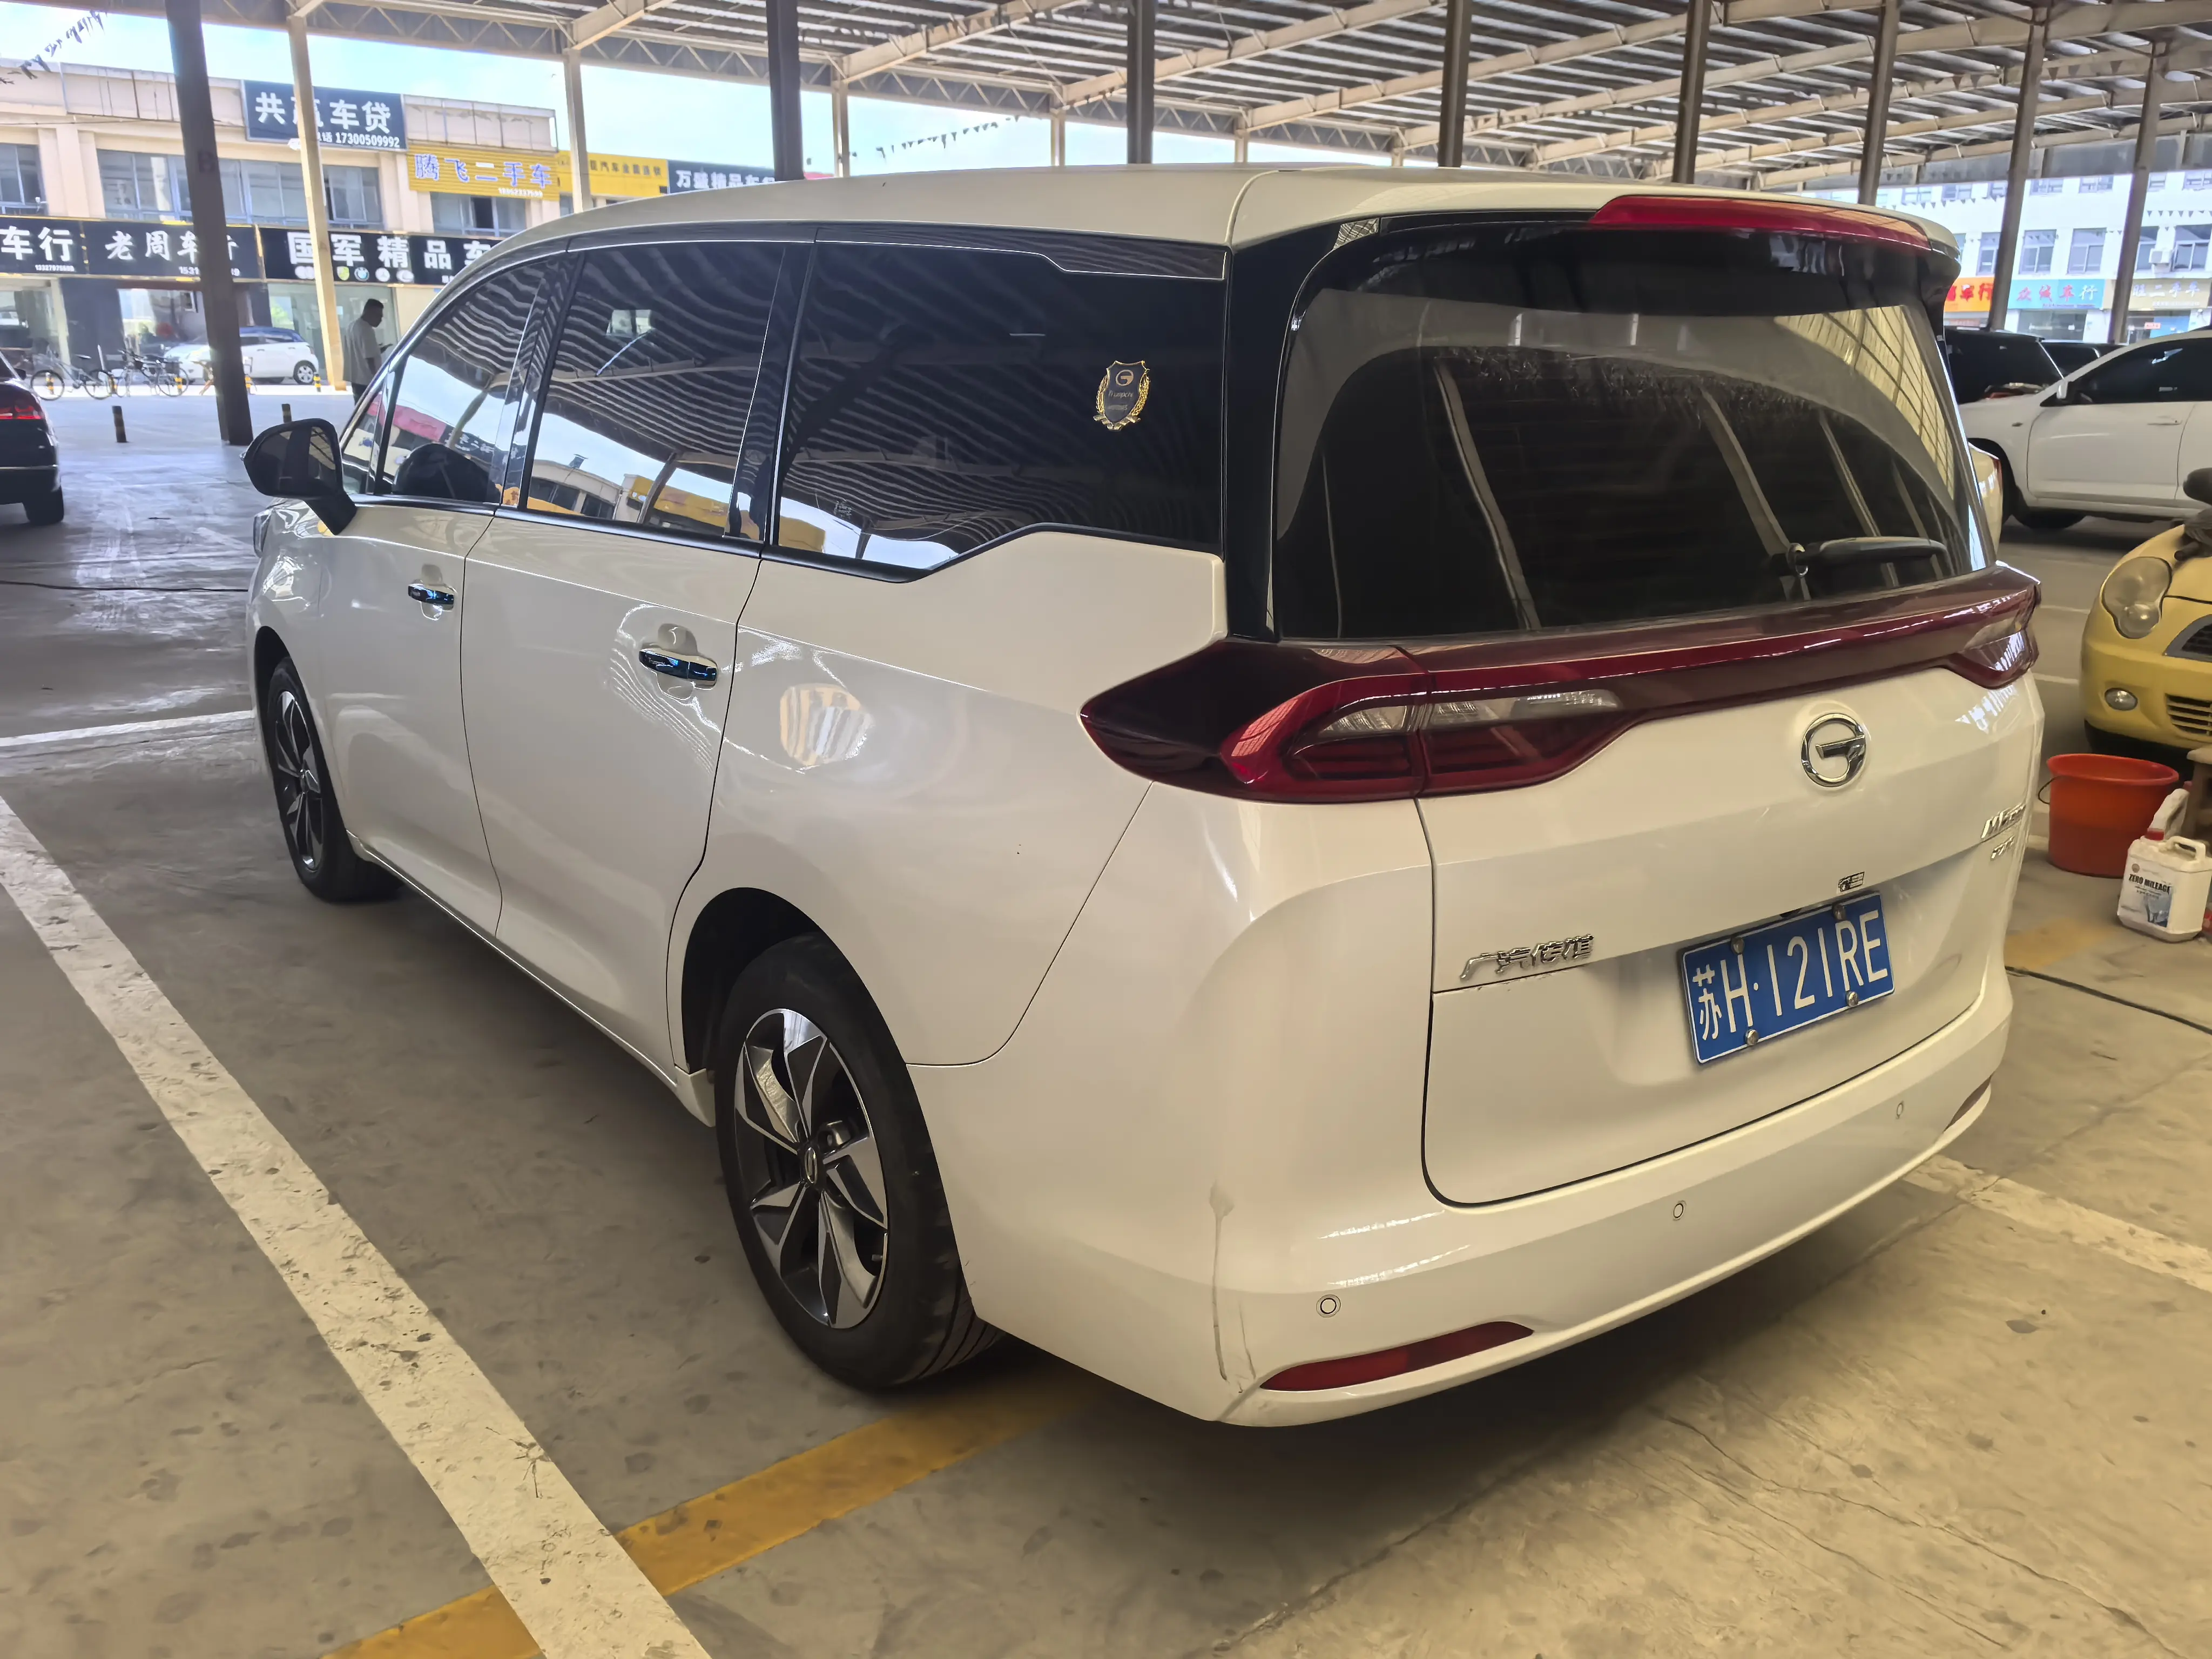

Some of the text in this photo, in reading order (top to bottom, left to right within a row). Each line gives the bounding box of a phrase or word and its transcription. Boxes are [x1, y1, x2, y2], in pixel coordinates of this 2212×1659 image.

[335, 132, 401, 148] 17300509992
[414, 153, 552, 189] 腾飞二手车
[0, 225, 73, 262] 车行
[2128, 874, 2143, 885] ZERO
